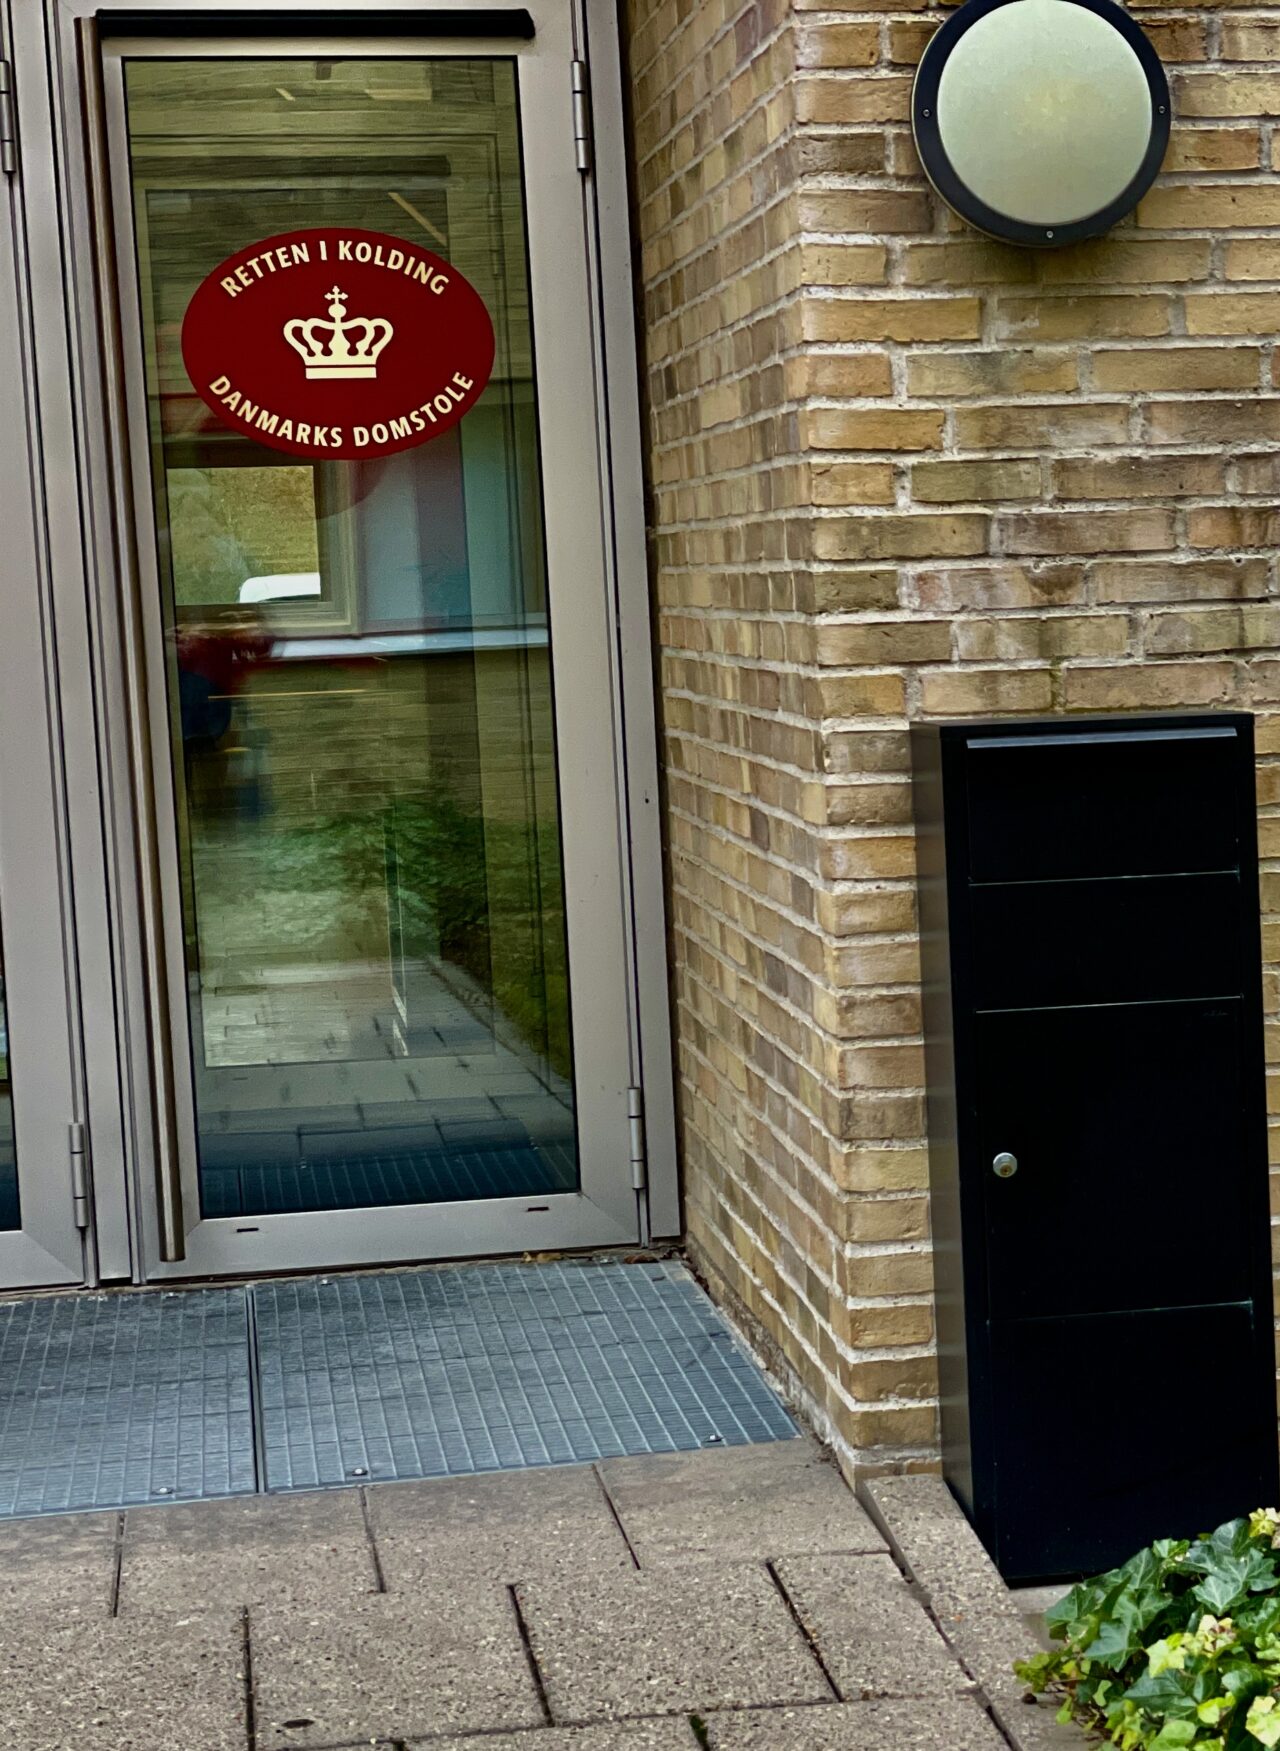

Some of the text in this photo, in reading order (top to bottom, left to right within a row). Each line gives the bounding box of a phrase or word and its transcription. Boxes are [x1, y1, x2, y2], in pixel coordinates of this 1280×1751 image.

[220, 240, 450, 298] RETTEN I KOLDING
[209, 371, 474, 448] DANMARKS DOMSTOLE
